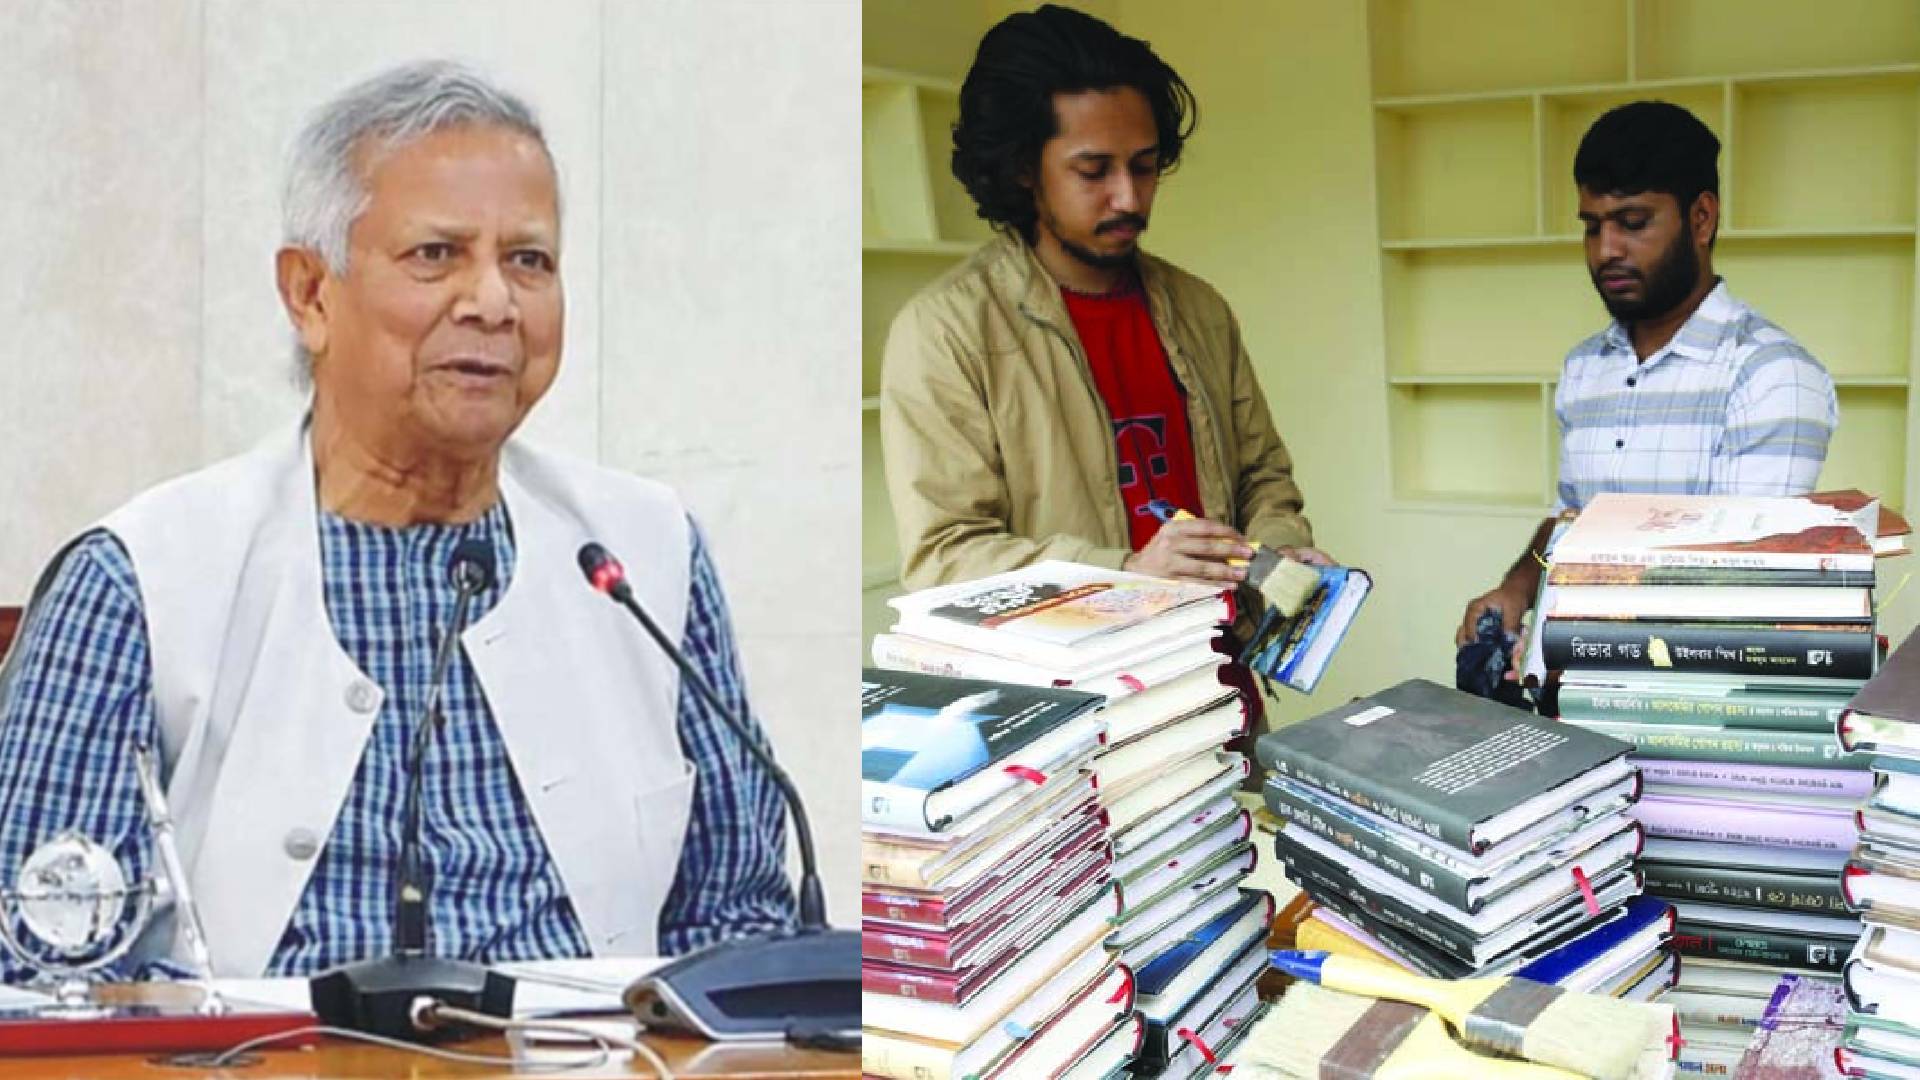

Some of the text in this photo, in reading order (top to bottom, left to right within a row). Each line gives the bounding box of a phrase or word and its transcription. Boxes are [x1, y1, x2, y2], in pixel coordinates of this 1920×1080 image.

[1571, 635, 1612, 658] রিভার
[1618, 642, 1642, 658] গড
[1674, 646, 1713, 661] উইলবার
